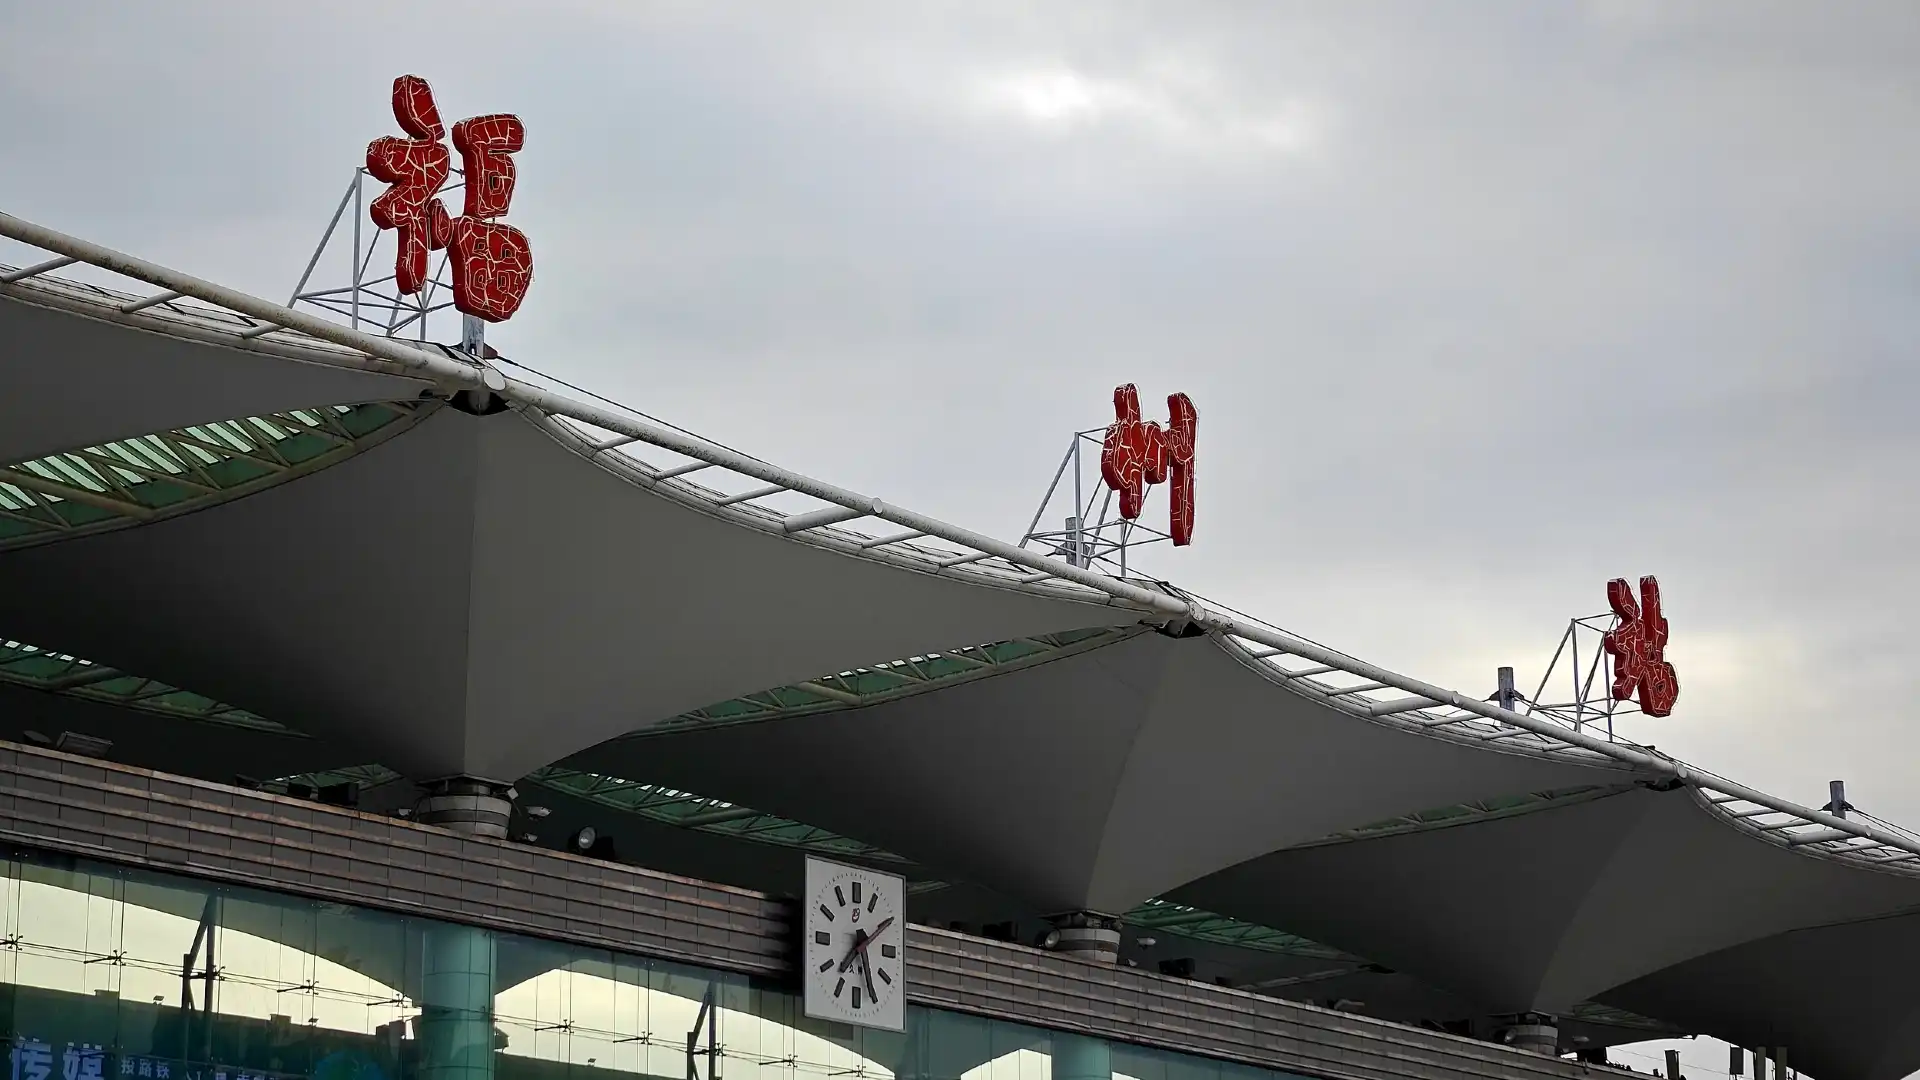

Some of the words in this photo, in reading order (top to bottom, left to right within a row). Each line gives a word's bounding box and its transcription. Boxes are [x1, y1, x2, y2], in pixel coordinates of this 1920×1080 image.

[366, 74, 533, 323] 福
[1101, 382, 1198, 547] 州
[1604, 574, 1680, 718] 站
